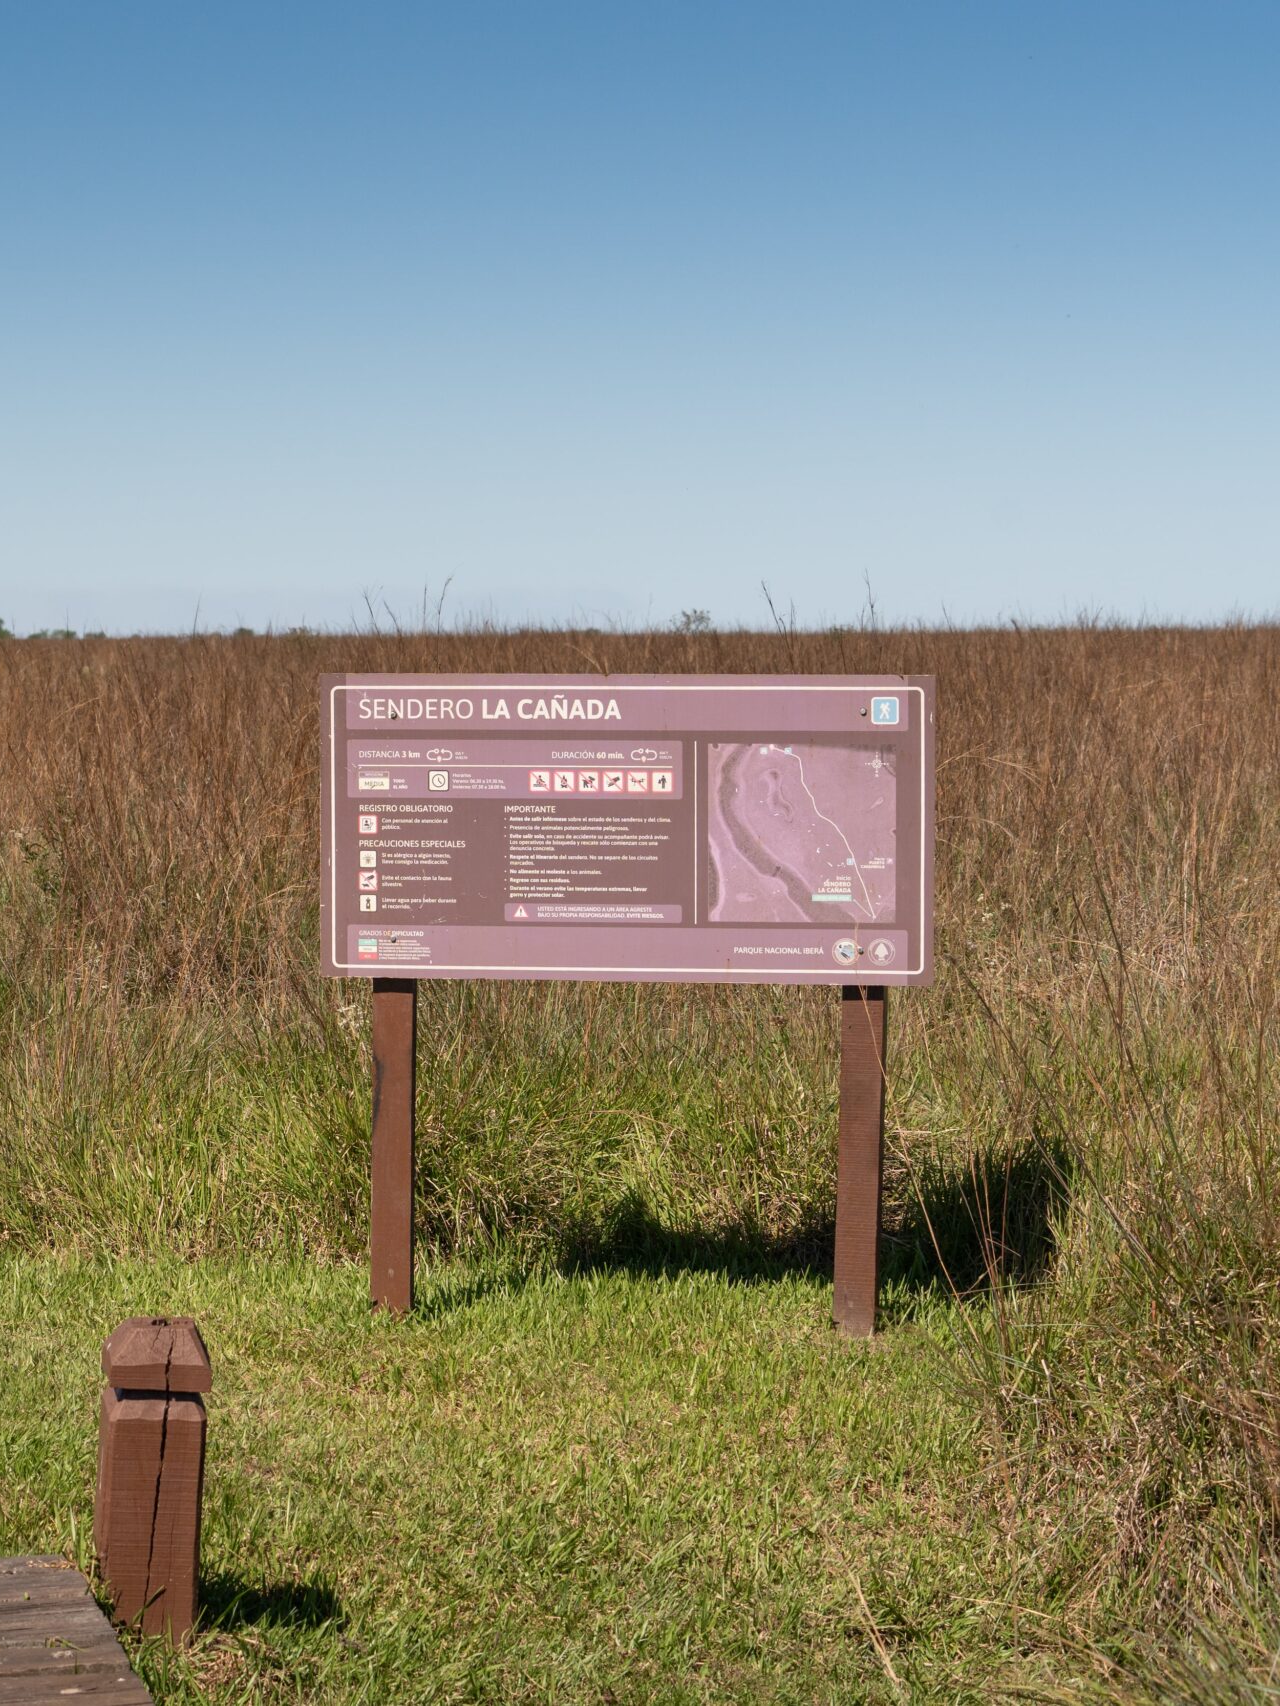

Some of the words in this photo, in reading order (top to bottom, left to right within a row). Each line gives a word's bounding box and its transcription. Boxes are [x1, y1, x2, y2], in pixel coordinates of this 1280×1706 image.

[359, 698, 473, 718] SENDERO
[482, 699, 510, 719] LA
[517, 694, 622, 719] CAÑADA
[552, 750, 594, 758] DURACIÓN
[803, 946, 824, 954] IBERÁ
